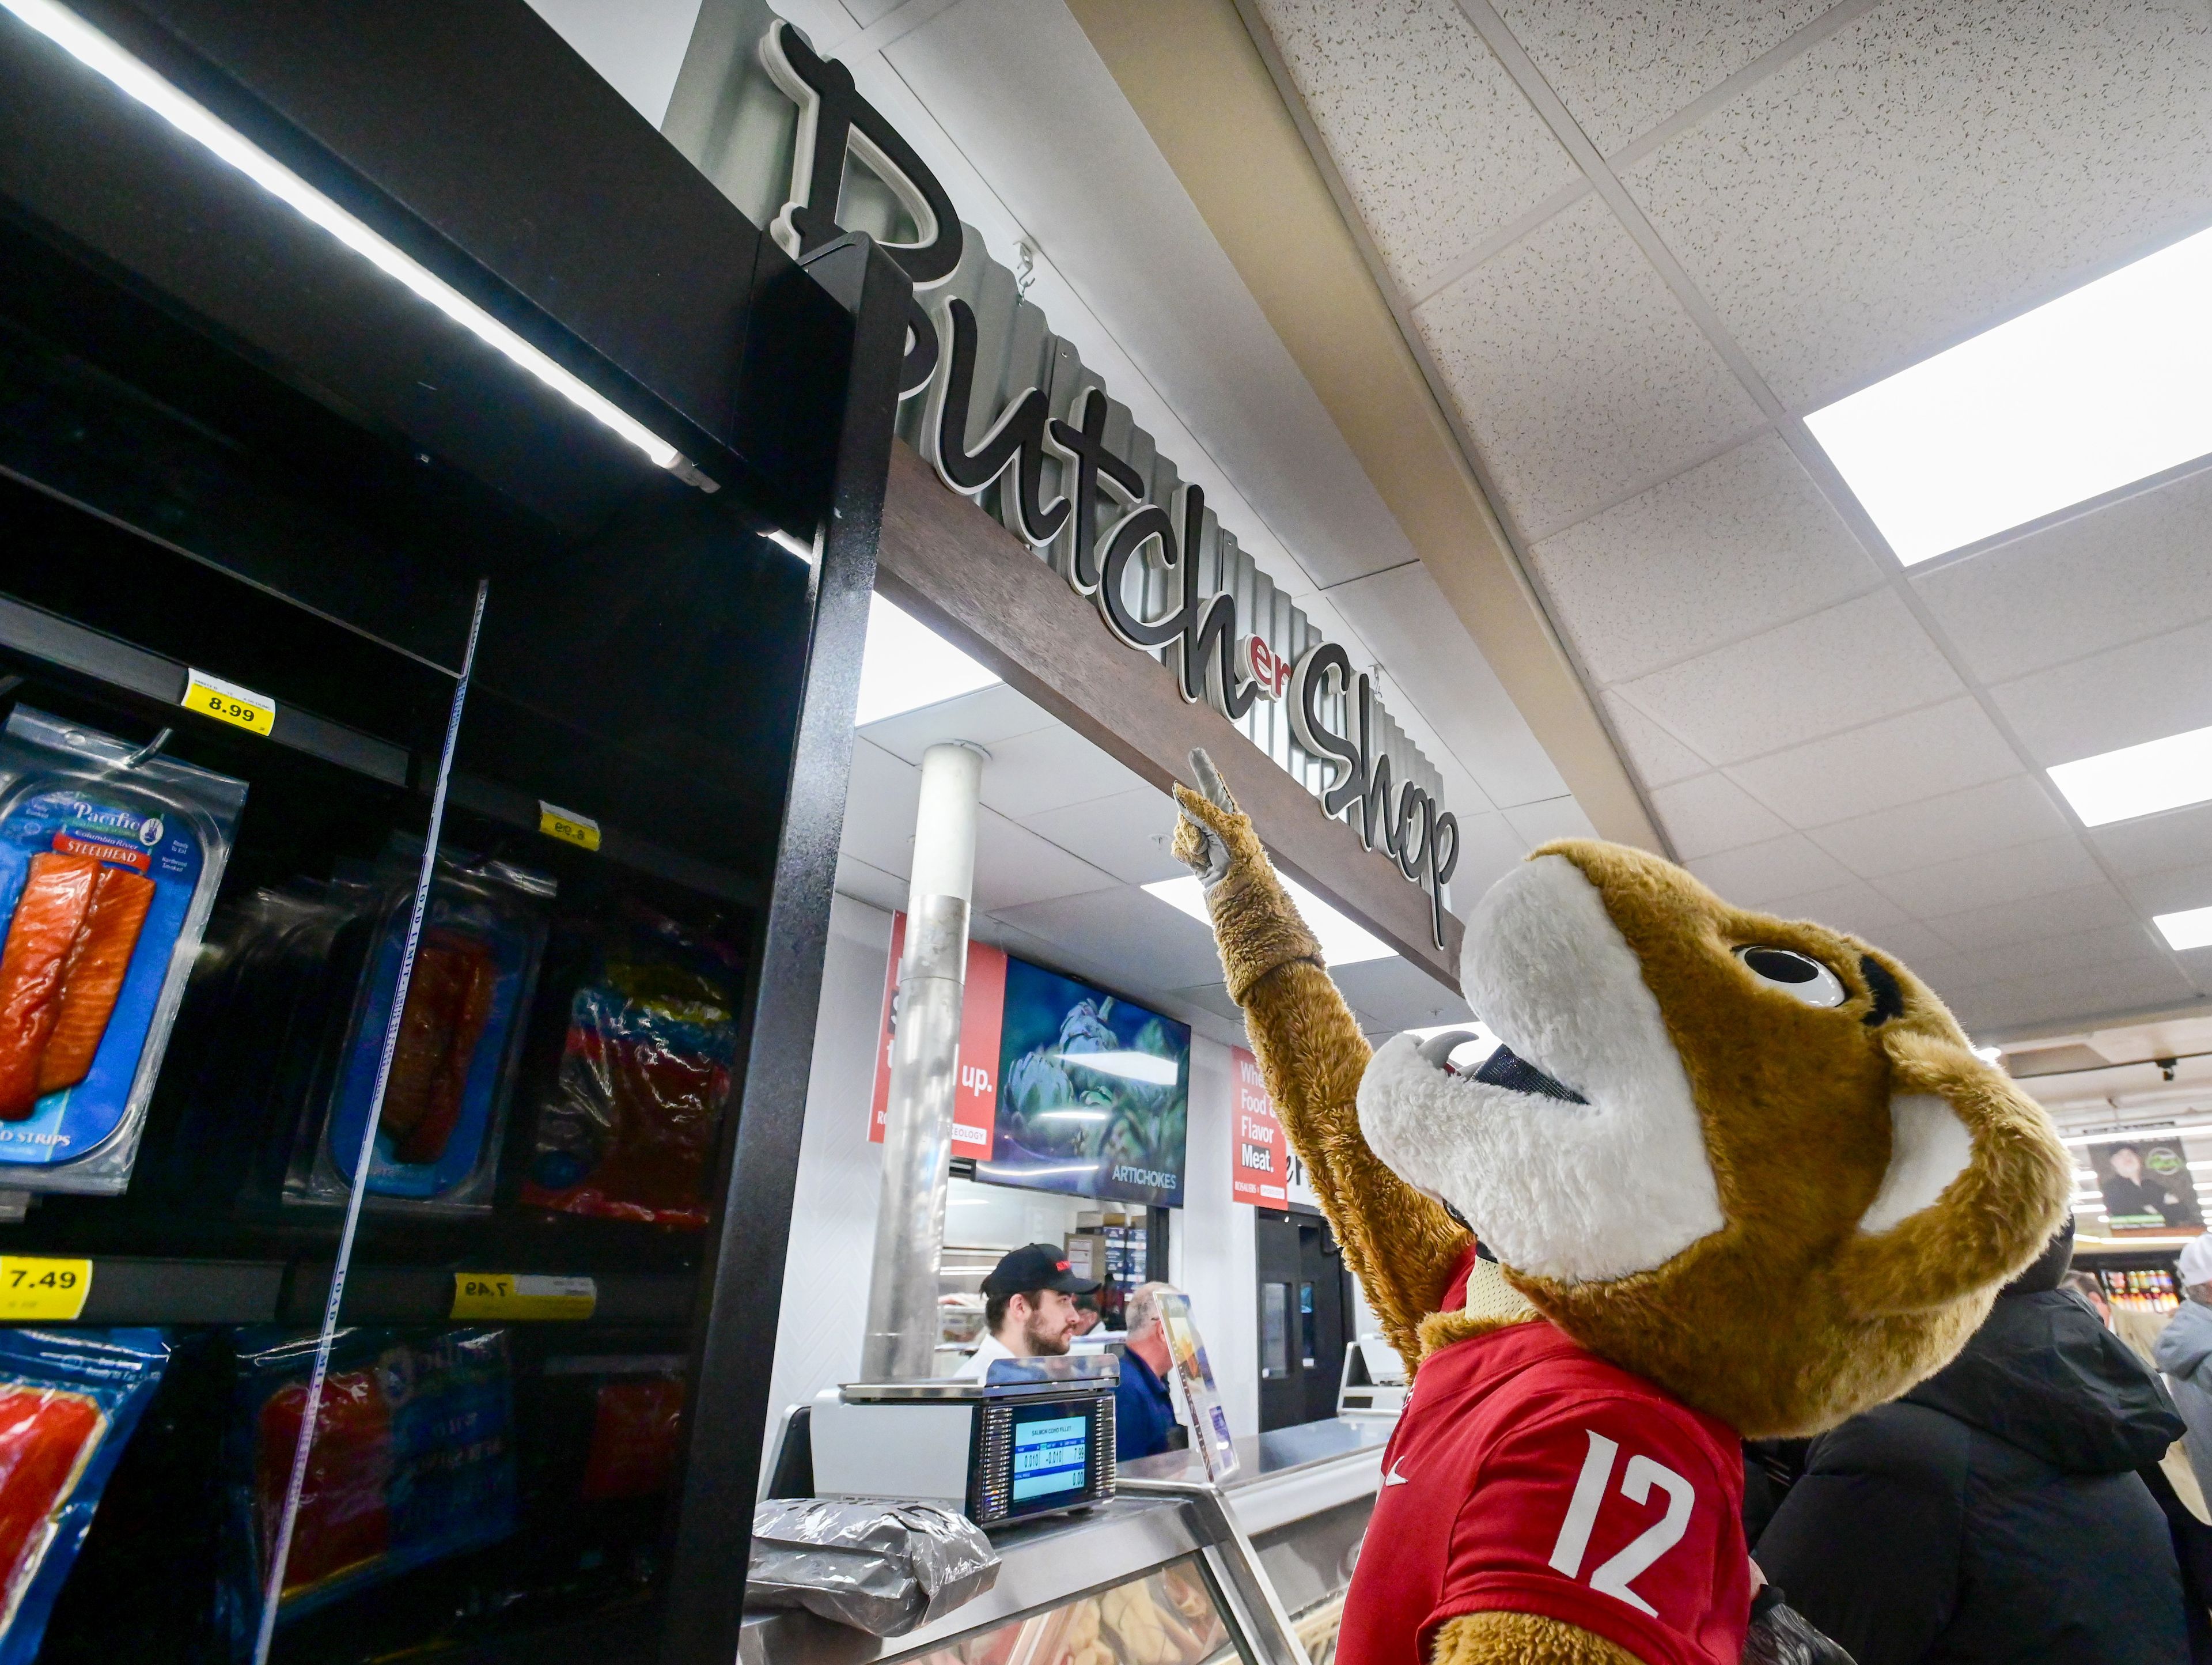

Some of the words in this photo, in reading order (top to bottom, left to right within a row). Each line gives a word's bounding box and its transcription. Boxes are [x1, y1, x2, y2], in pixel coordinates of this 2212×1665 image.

[209, 697, 255, 722] 8.99
[1289, 642, 1460, 951] Shop
[74, 801, 141, 830] Pacific
[68, 841, 138, 864] STEELHEAD
[75, 830, 115, 845] Columbia
[117, 839, 138, 850] River
[962, 1065, 993, 1097] up.
[1241, 1088, 1267, 1115] Food
[16, 1132, 71, 1146] STRIPS
[1241, 1115, 1274, 1144] Flavor
[1241, 1143, 1275, 1174] Meat.
[1112, 1164, 1177, 1190] ARTICHOKES
[10, 1270, 76, 1289] 7.49
[1024, 1454, 1039, 1468] 0.010
[1548, 1429, 1695, 1618] 12
